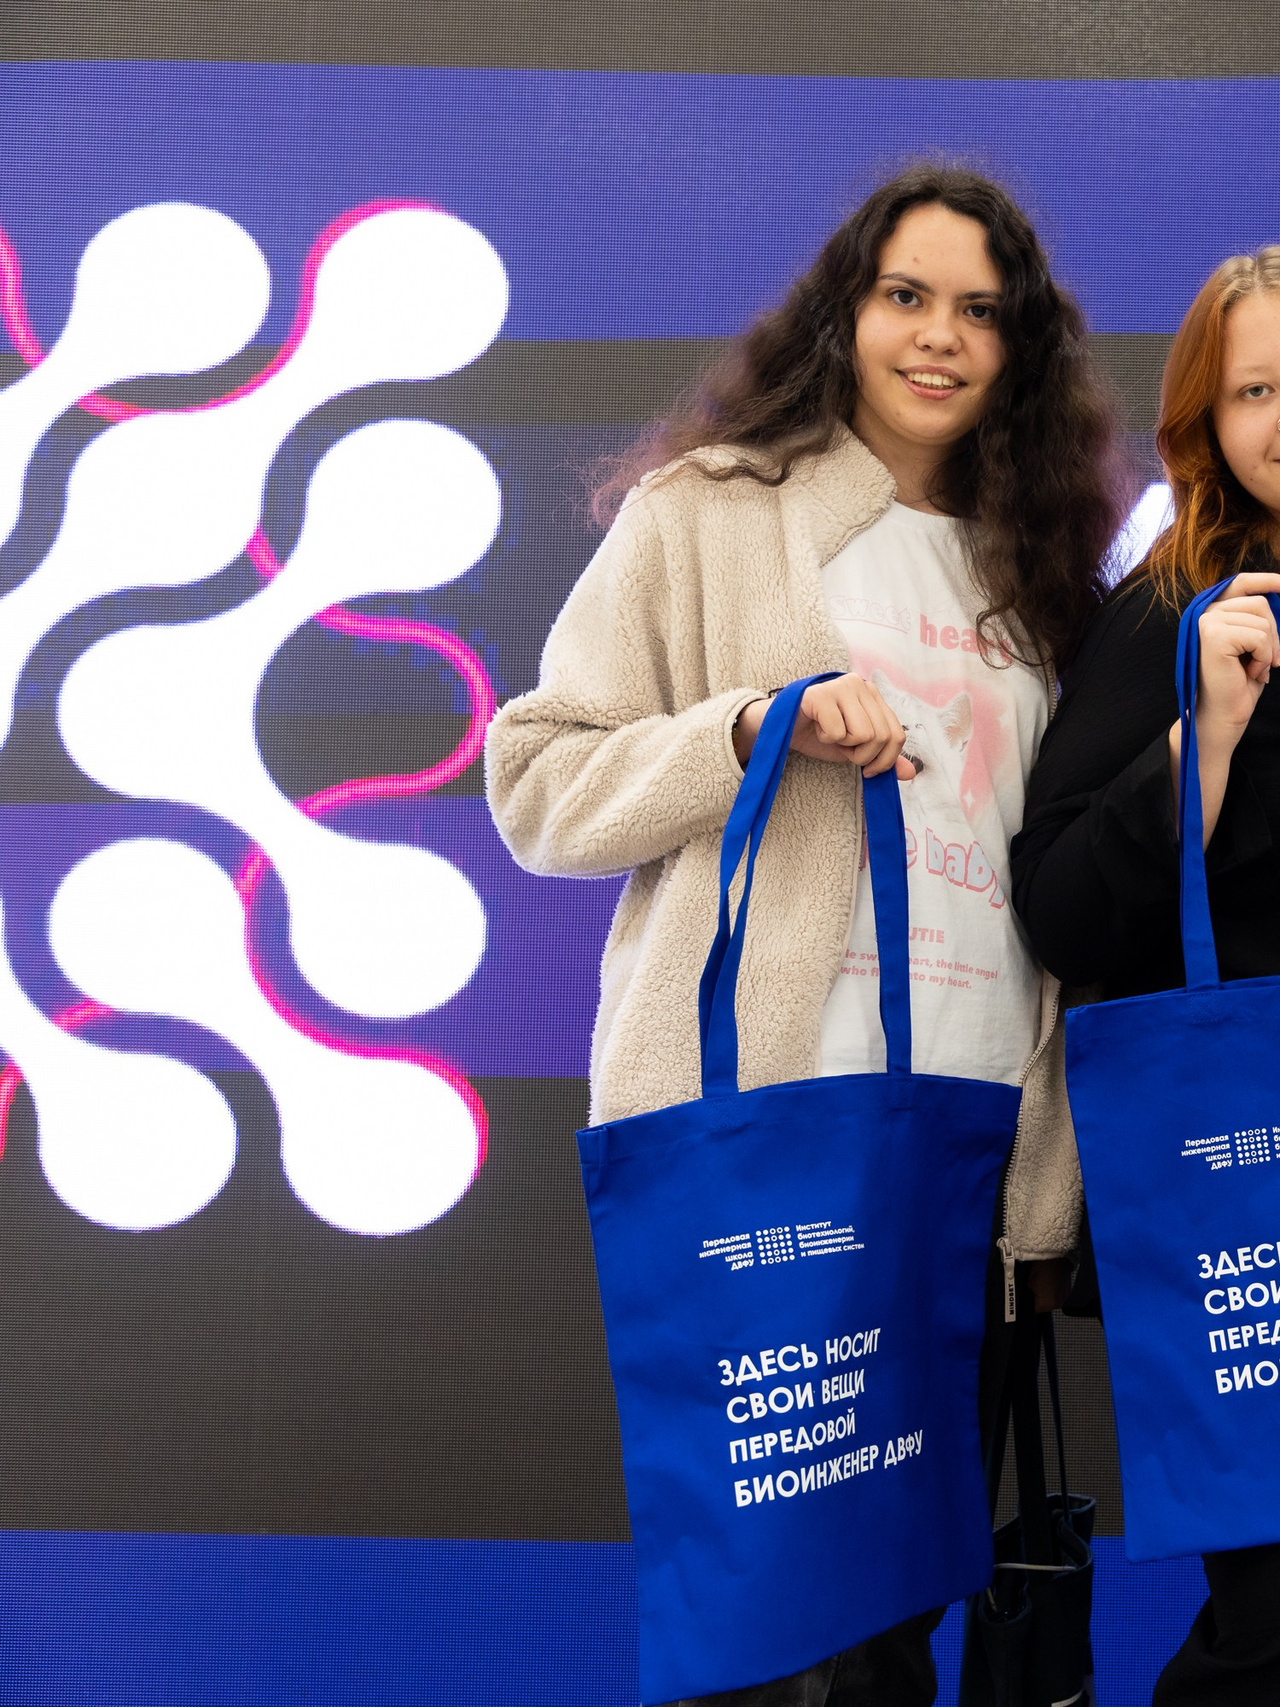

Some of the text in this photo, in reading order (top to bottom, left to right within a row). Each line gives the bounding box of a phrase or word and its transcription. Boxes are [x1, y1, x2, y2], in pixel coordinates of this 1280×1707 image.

[936, 959, 953, 970] the
[954, 961, 974, 974] little
[975, 968, 998, 980] angel
[929, 975, 946, 986] my
[1185, 1134, 1229, 1147] Передовая
[1181, 1143, 1230, 1157] инженерная
[1205, 1152, 1232, 1162] школа
[1211, 1159, 1233, 1170] ДВФУ
[796, 1221, 831, 1232] Институт
[797, 1225, 855, 1240] биотехнологий,
[703, 1233, 750, 1249] Передовая
[799, 1235, 855, 1249] биоинженерии
[699, 1241, 752, 1258] инженерная
[725, 1251, 754, 1262] школа
[731, 1258, 755, 1271] ДВФУ
[717, 1328, 881, 1386] ЗДЕСЬ НОСИТ
[726, 1368, 865, 1424] СВОИ ВЕЩИ
[729, 1407, 856, 1464] ПЕРЕДОВОЙ
[734, 1429, 923, 1507] БИОИНЖЕНЕР ДВФУ
